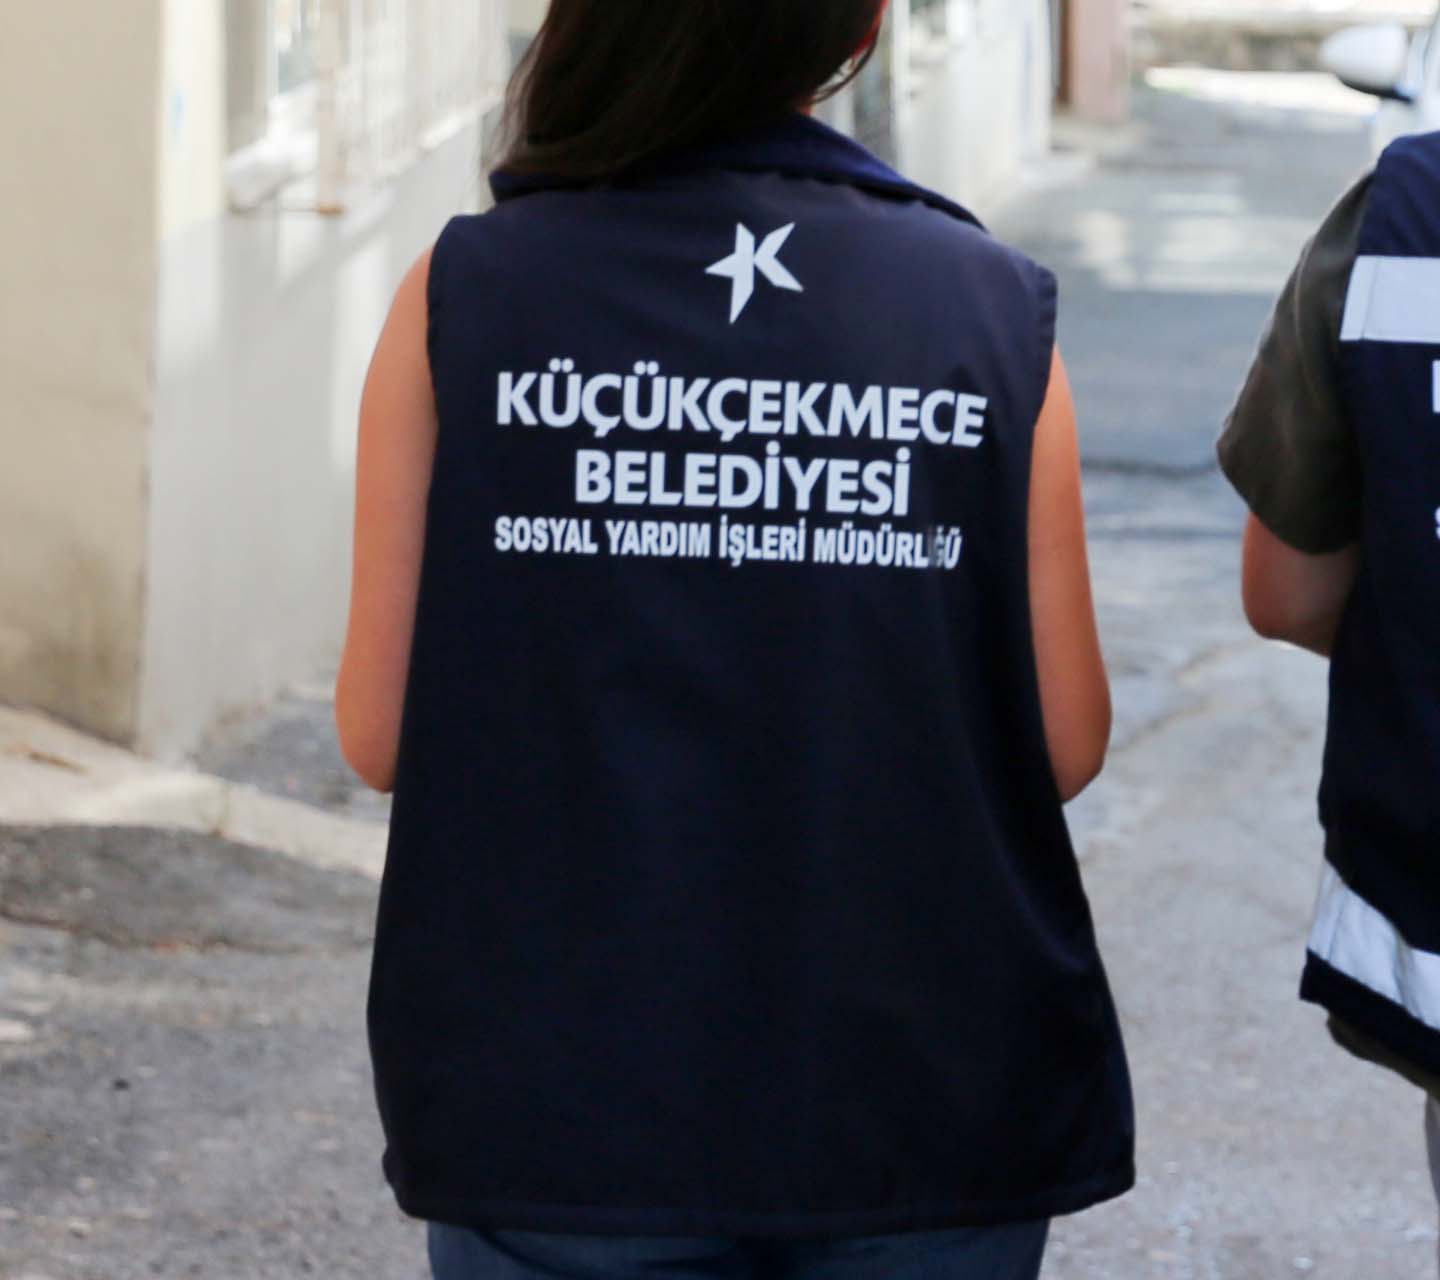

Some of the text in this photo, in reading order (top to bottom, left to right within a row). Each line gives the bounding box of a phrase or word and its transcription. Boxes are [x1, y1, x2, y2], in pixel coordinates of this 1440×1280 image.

[496, 358, 988, 448] KÜÇÜKÇEKMECE
[575, 439, 911, 517] BELEDİYESİ
[495, 515, 963, 569] SOSYAL YARDIM İŞLERİ MÜDÜRLĞÜ
